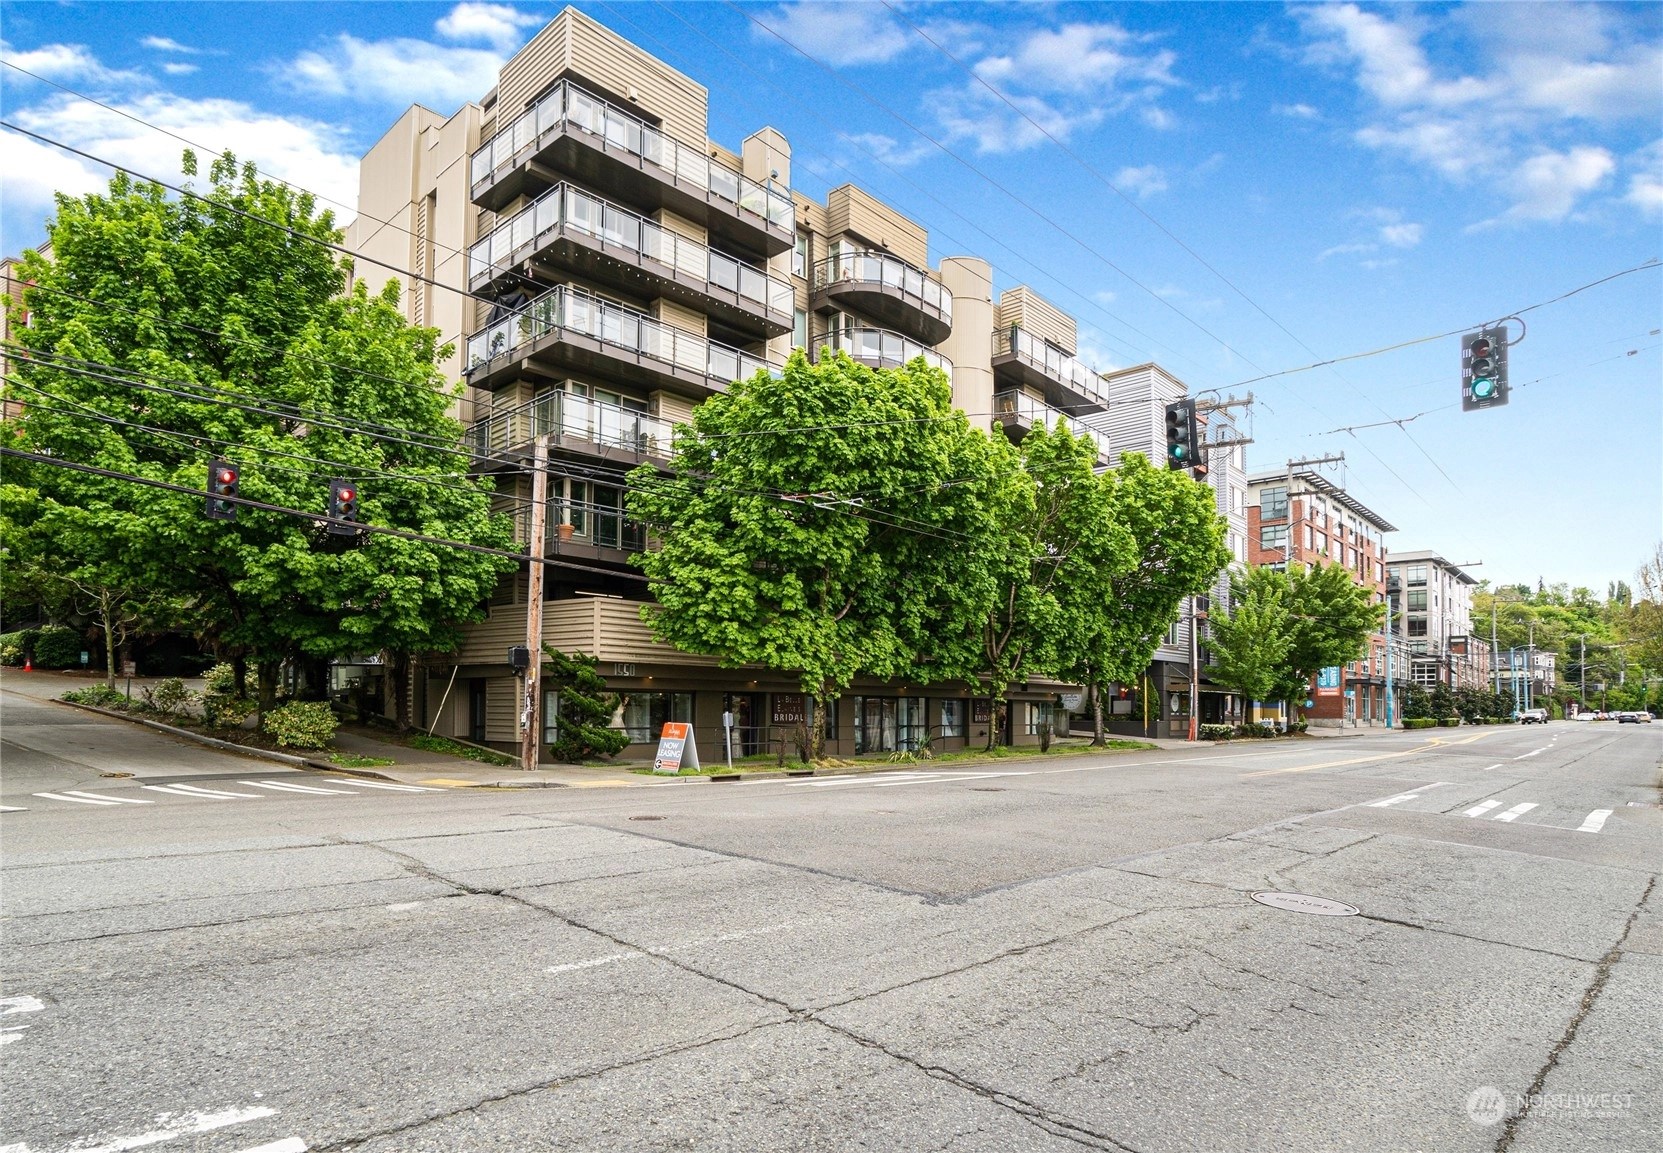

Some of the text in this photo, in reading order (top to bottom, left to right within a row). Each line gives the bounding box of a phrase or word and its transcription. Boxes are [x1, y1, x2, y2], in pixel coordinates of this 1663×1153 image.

[614, 663, 636, 677] 1550
[774, 713, 804, 722] BRIDAL
[663, 742, 679, 750] NOW
[657, 749, 681, 758] LEASING
